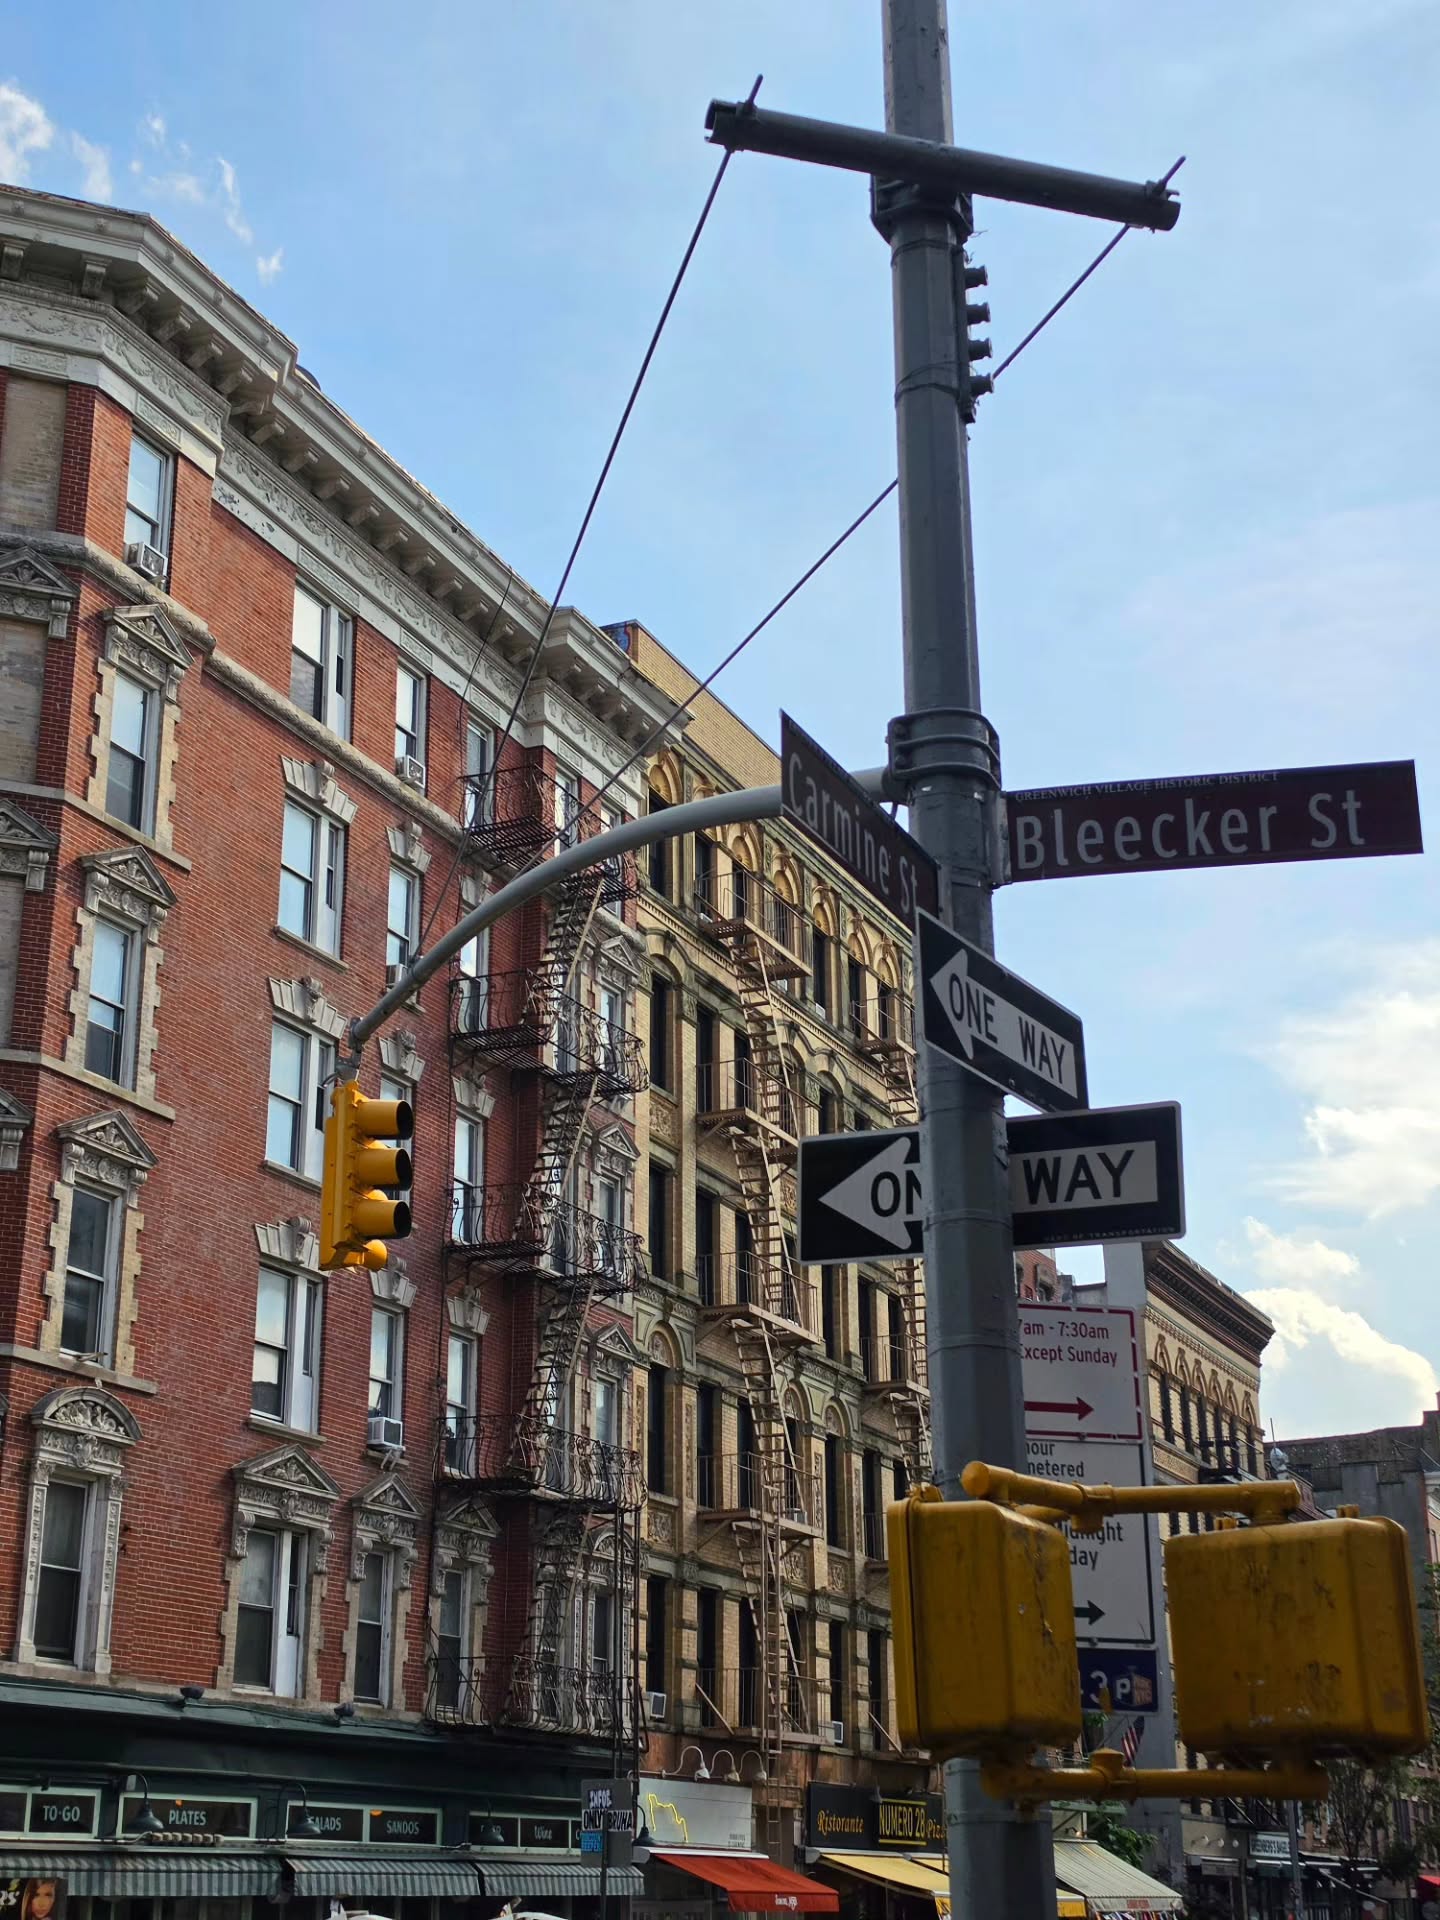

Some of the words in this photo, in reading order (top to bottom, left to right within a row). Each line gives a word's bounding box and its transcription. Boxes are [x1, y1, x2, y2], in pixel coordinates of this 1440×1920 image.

[1016, 785, 1091, 801] GREENWICH
[1096, 780, 1152, 794] VILLAGE
[1155, 775, 1215, 789] HISTORIC
[1218, 771, 1279, 785] DISTRICT
[789, 752, 890, 895] Carmine
[899, 856, 918, 913] St
[1016, 798, 1277, 870] Bleecker
[1308, 790, 1365, 848] St
[949, 973, 998, 1044] ONE
[1018, 1016, 1066, 1084] WAY
[870, 1169, 922, 1218] ON
[1022, 1149, 1135, 1205] WAY
[1057, 1321, 1109, 1339] 7:30am
[1020, 1343, 1064, 1365] xcept
[1067, 1346, 1117, 1368] Sunday
[1070, 1545, 1098, 1571] day
[168, 1808, 207, 1826] PLATES
[386, 1820, 420, 1835] SANDOS
[817, 1810, 864, 1836] Ristorante
[879, 1804, 913, 1837] NUMERO
[914, 1807, 926, 1838] 28
[926, 1819, 945, 1840] Pizz
